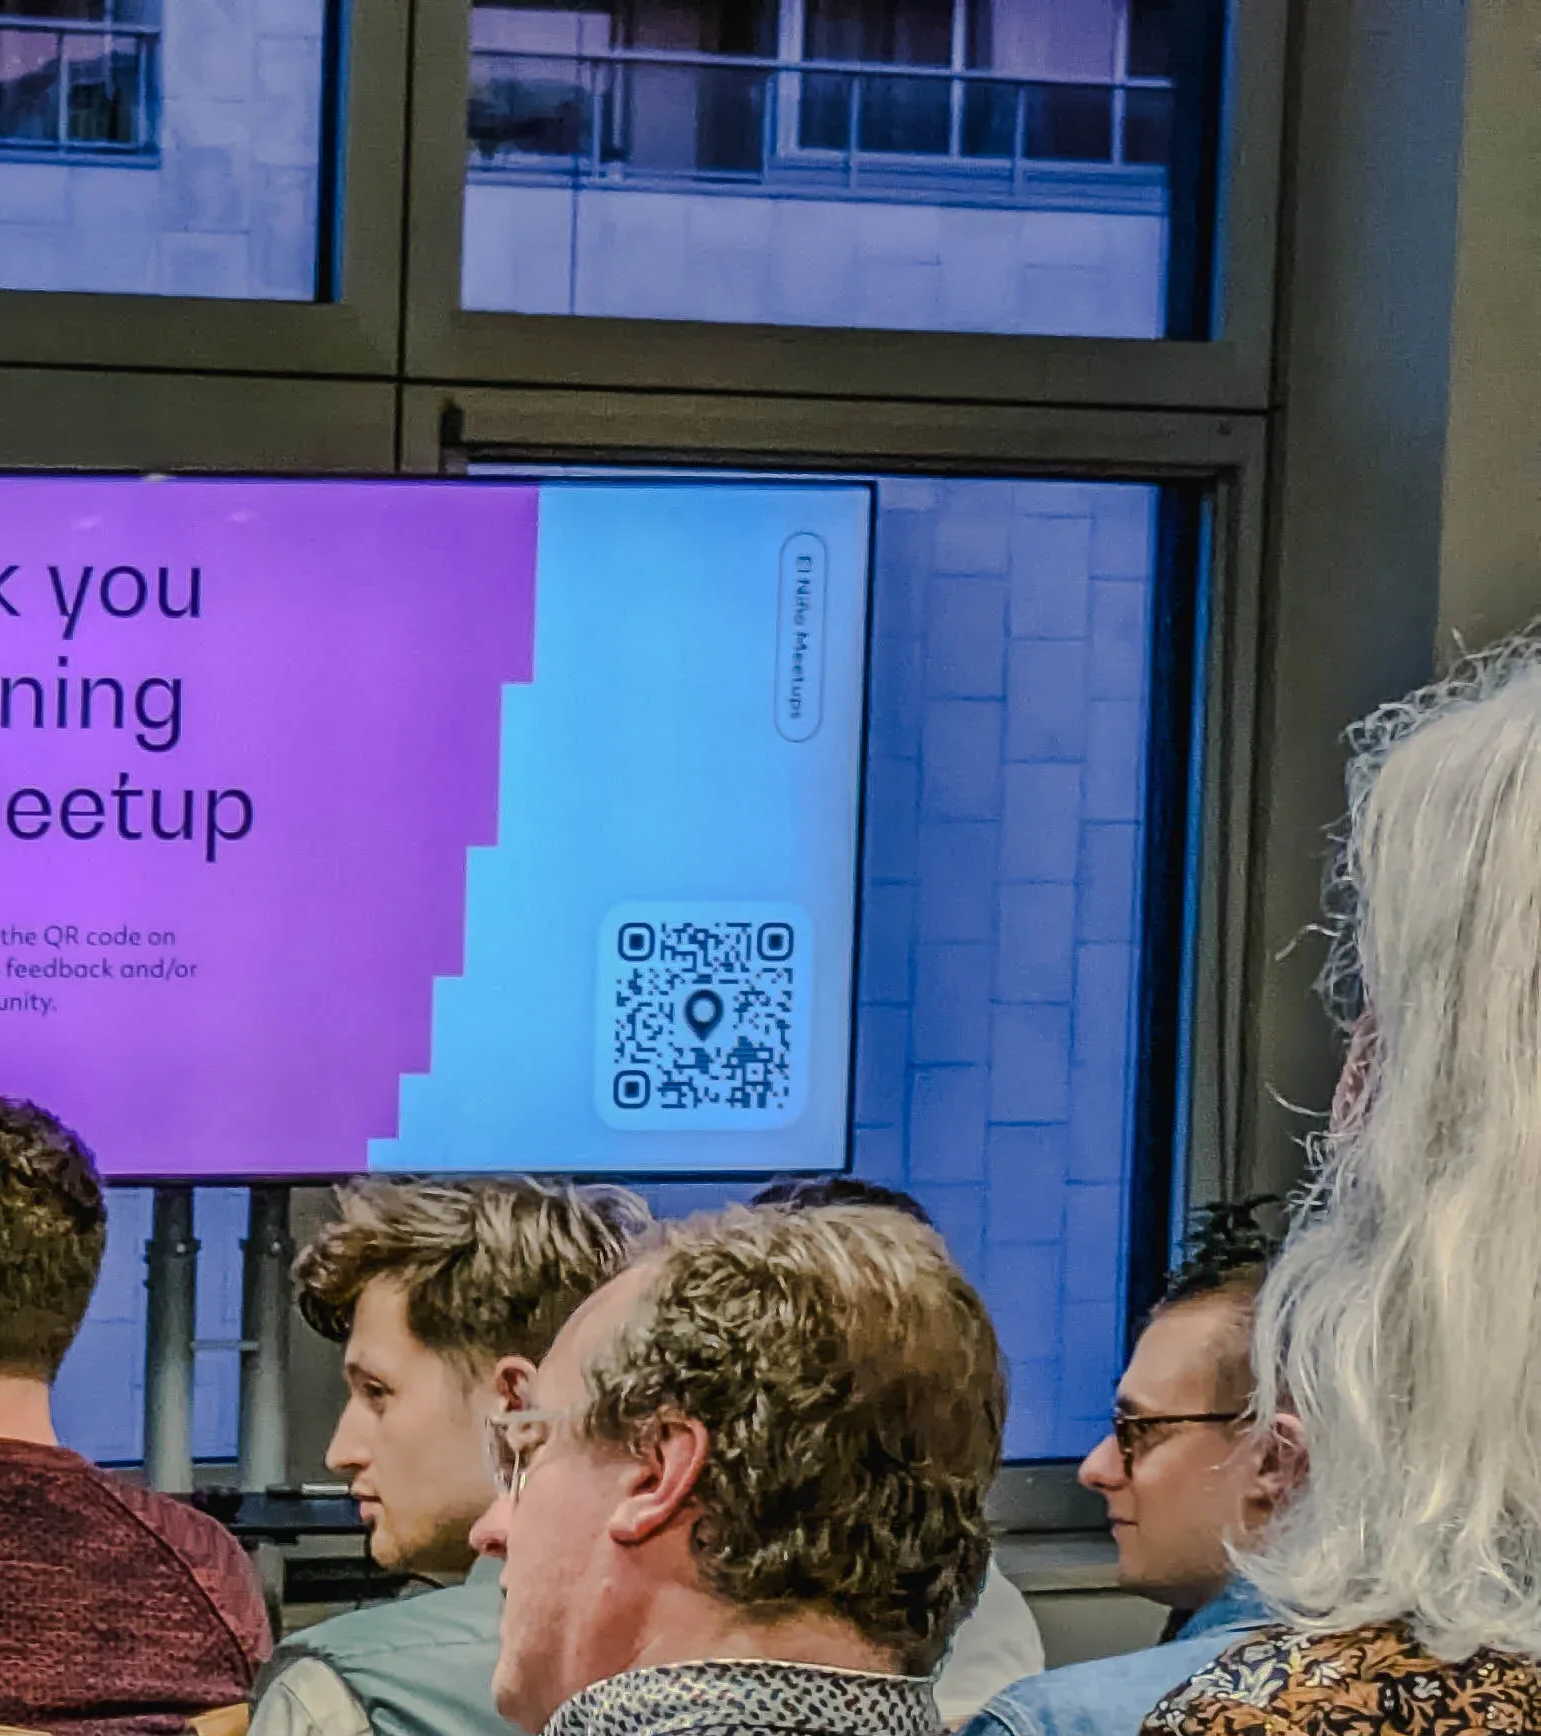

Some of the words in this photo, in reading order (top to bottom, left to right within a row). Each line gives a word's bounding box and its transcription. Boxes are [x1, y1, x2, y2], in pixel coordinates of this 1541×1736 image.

[47, 564, 201, 641] you
[788, 630, 808, 720] Meetups
[0, 925, 37, 946] the
[44, 925, 79, 948] QR
[86, 926, 142, 946] code
[148, 931, 177, 946] on
[6, 956, 113, 979] feedback
[119, 957, 198, 982] and/or
